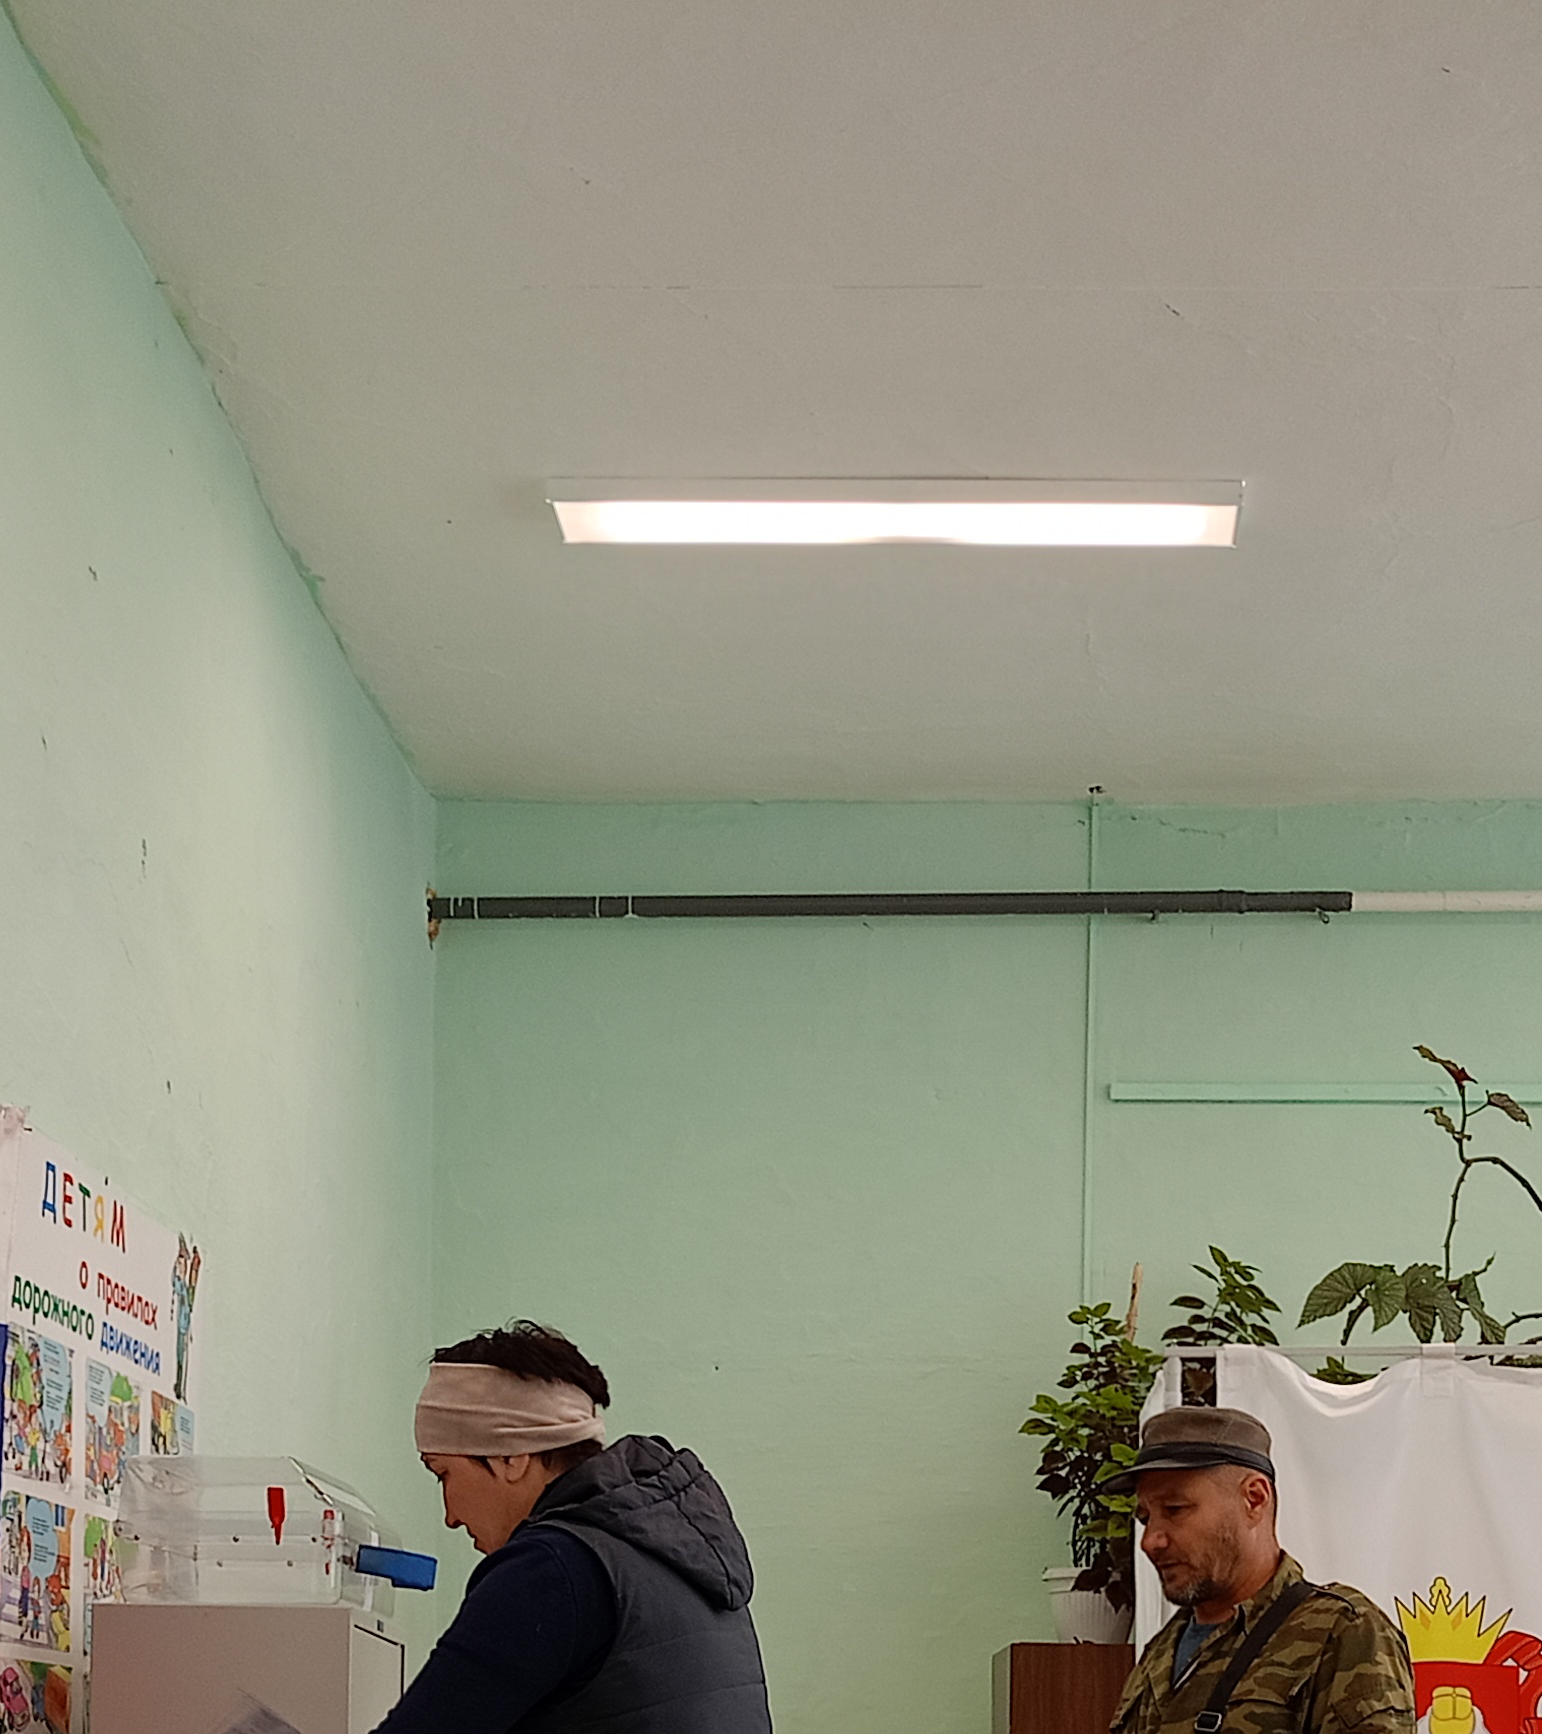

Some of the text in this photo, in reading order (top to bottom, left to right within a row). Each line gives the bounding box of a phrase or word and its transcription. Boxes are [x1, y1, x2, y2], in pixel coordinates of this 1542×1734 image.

[42, 1160, 127, 1254] ДЕТЯМ
[10, 1274, 96, 1341] дорожного
[99, 1320, 162, 1377] движения
[78, 1260, 159, 1331] о правилах
